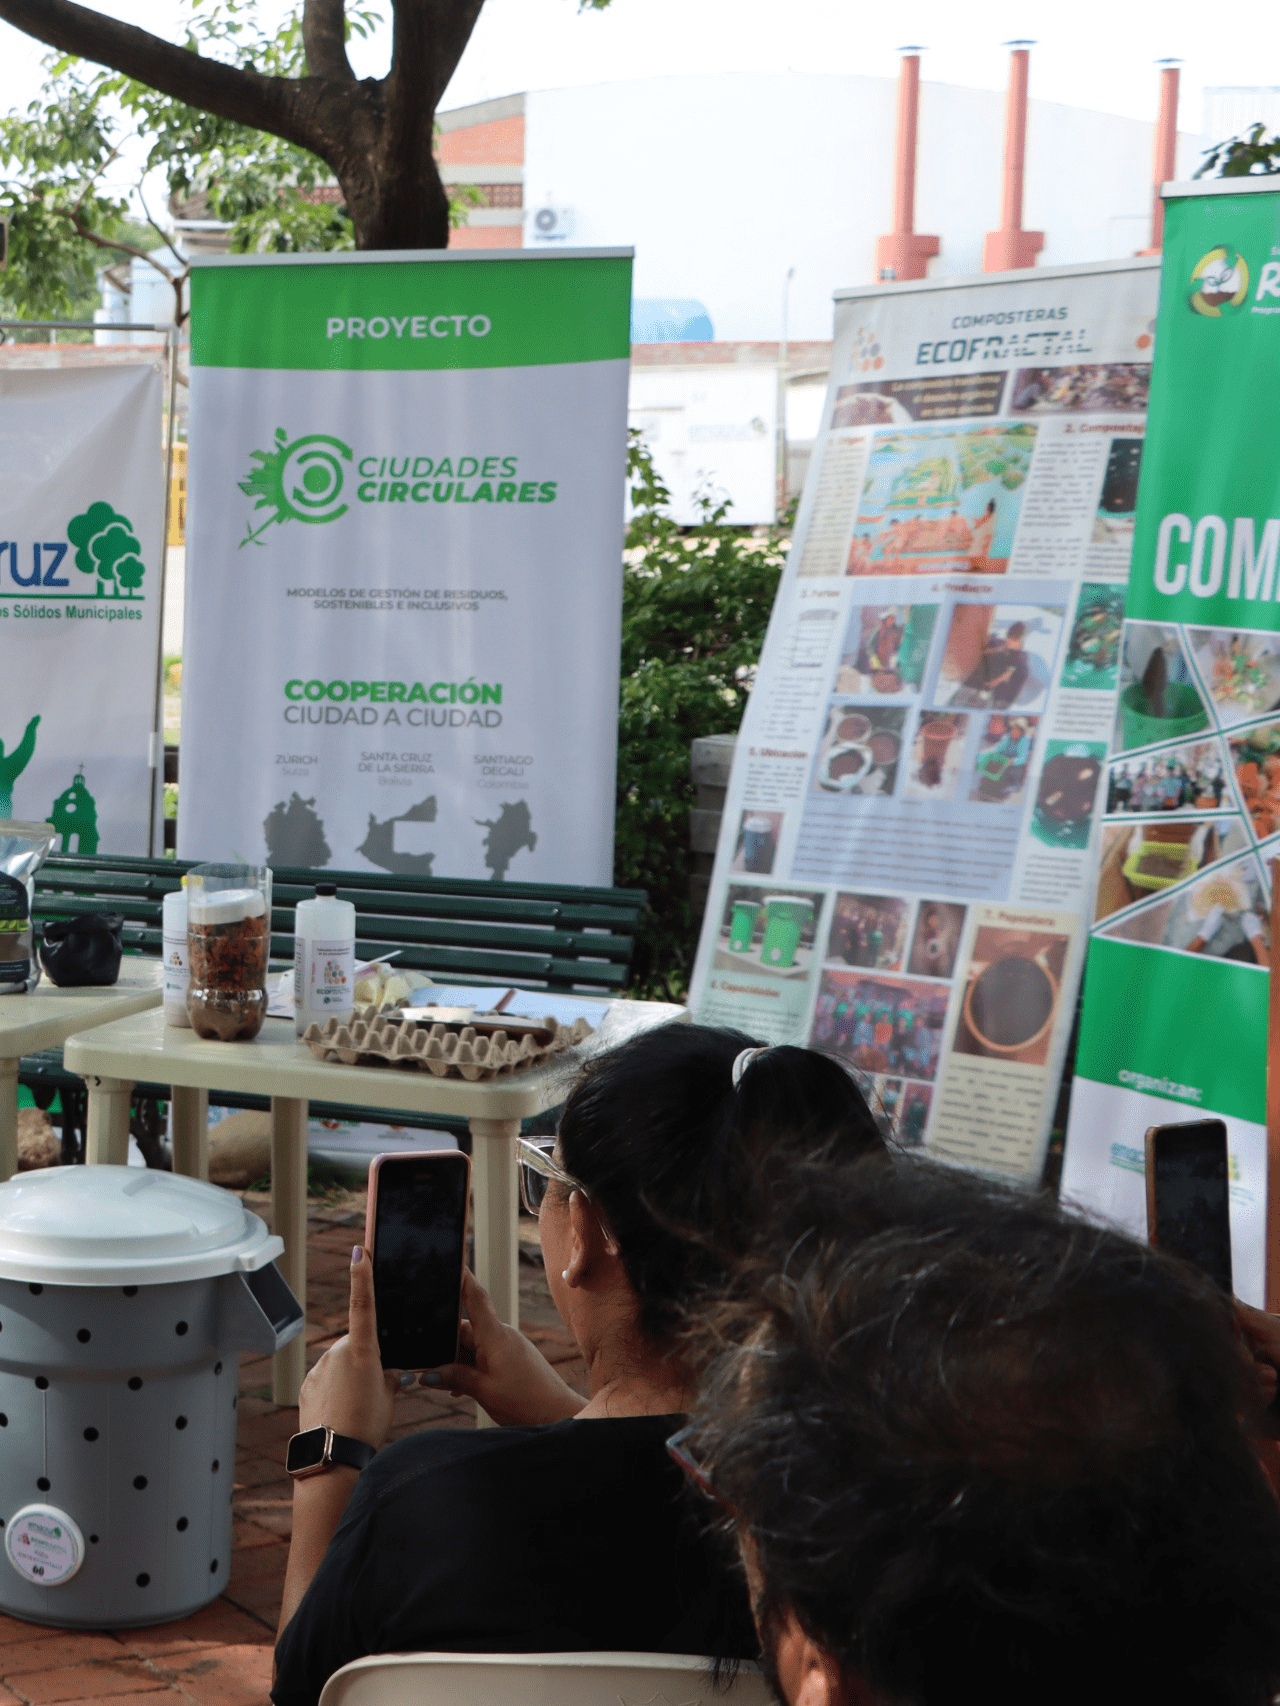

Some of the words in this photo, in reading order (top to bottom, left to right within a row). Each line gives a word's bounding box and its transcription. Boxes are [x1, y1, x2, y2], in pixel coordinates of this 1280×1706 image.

[326, 315, 492, 341] PROYECTO
[951, 307, 1068, 329] COMPOSTERAS
[915, 328, 1093, 366] ECOFRACTAL
[356, 456, 518, 479] CIUDADES
[356, 481, 558, 503] CIRCULARES
[1153, 512, 1280, 602] COM
[286, 587, 347, 599] MODELOS
[349, 588, 363, 599] DE
[369, 587, 420, 600] GESTIÓN
[423, 589, 440, 600] DE
[443, 589, 508, 601] RESIDUOS,
[314, 599, 393, 610] SOSTENIBLES
[397, 600, 405, 611] E
[407, 600, 480, 611] INCLUSIVOS
[13, 602, 62, 619] Sólidos
[65, 605, 143, 623] Municipales
[284, 676, 503, 705] COOPERACIÓN
[283, 705, 378, 725] CIUDAD
[383, 707, 402, 726] A
[406, 708, 503, 728] CIUDAD
[361, 751, 399, 762] SANTA
[401, 752, 433, 763] CRUZ
[474, 754, 534, 765] SANTIAGO
[358, 763, 374, 773] DE
[376, 763, 392, 773] LA
[393, 764, 435, 774] SIERRA
